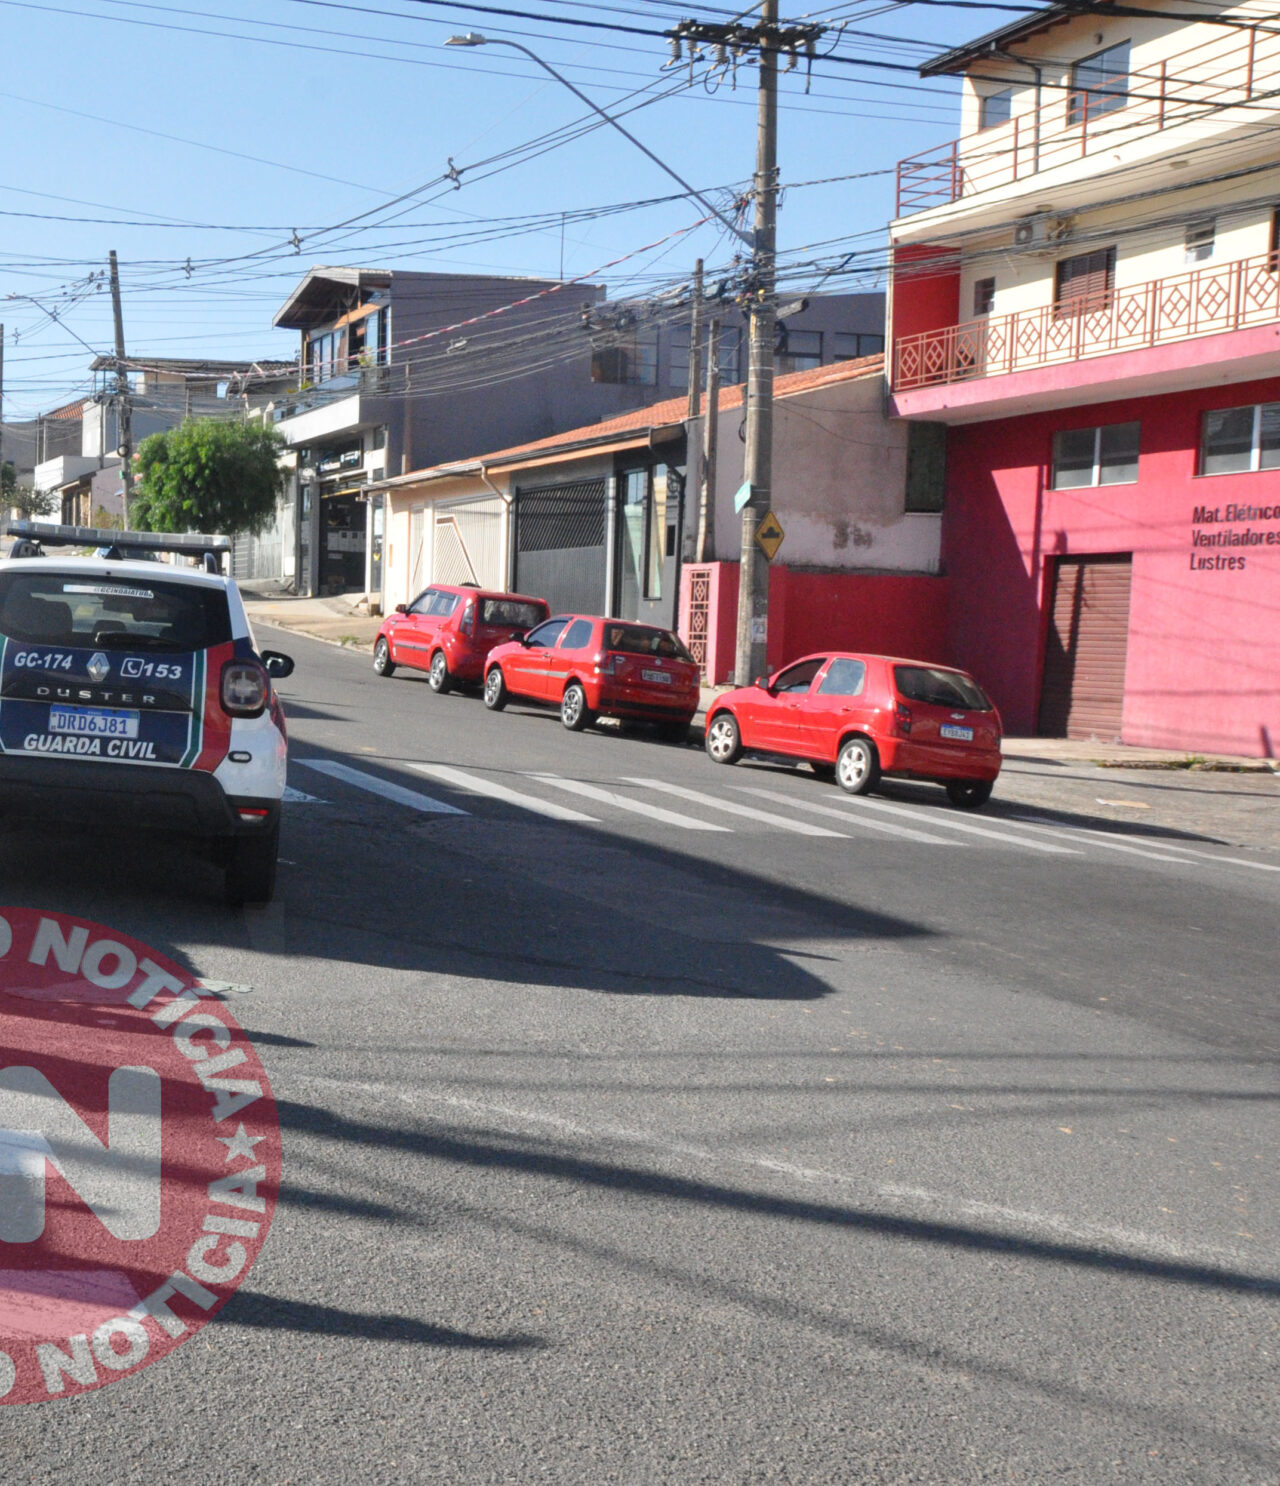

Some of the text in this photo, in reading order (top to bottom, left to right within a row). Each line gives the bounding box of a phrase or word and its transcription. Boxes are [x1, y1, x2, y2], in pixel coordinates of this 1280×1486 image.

[1190, 552, 1247, 571] Lustres
[13, 651, 183, 680] GC-174 153
[36, 686, 156, 704] DUSTER
[56, 713, 128, 735] DRD6J81
[22, 733, 157, 759] GUARDA CIVIL
